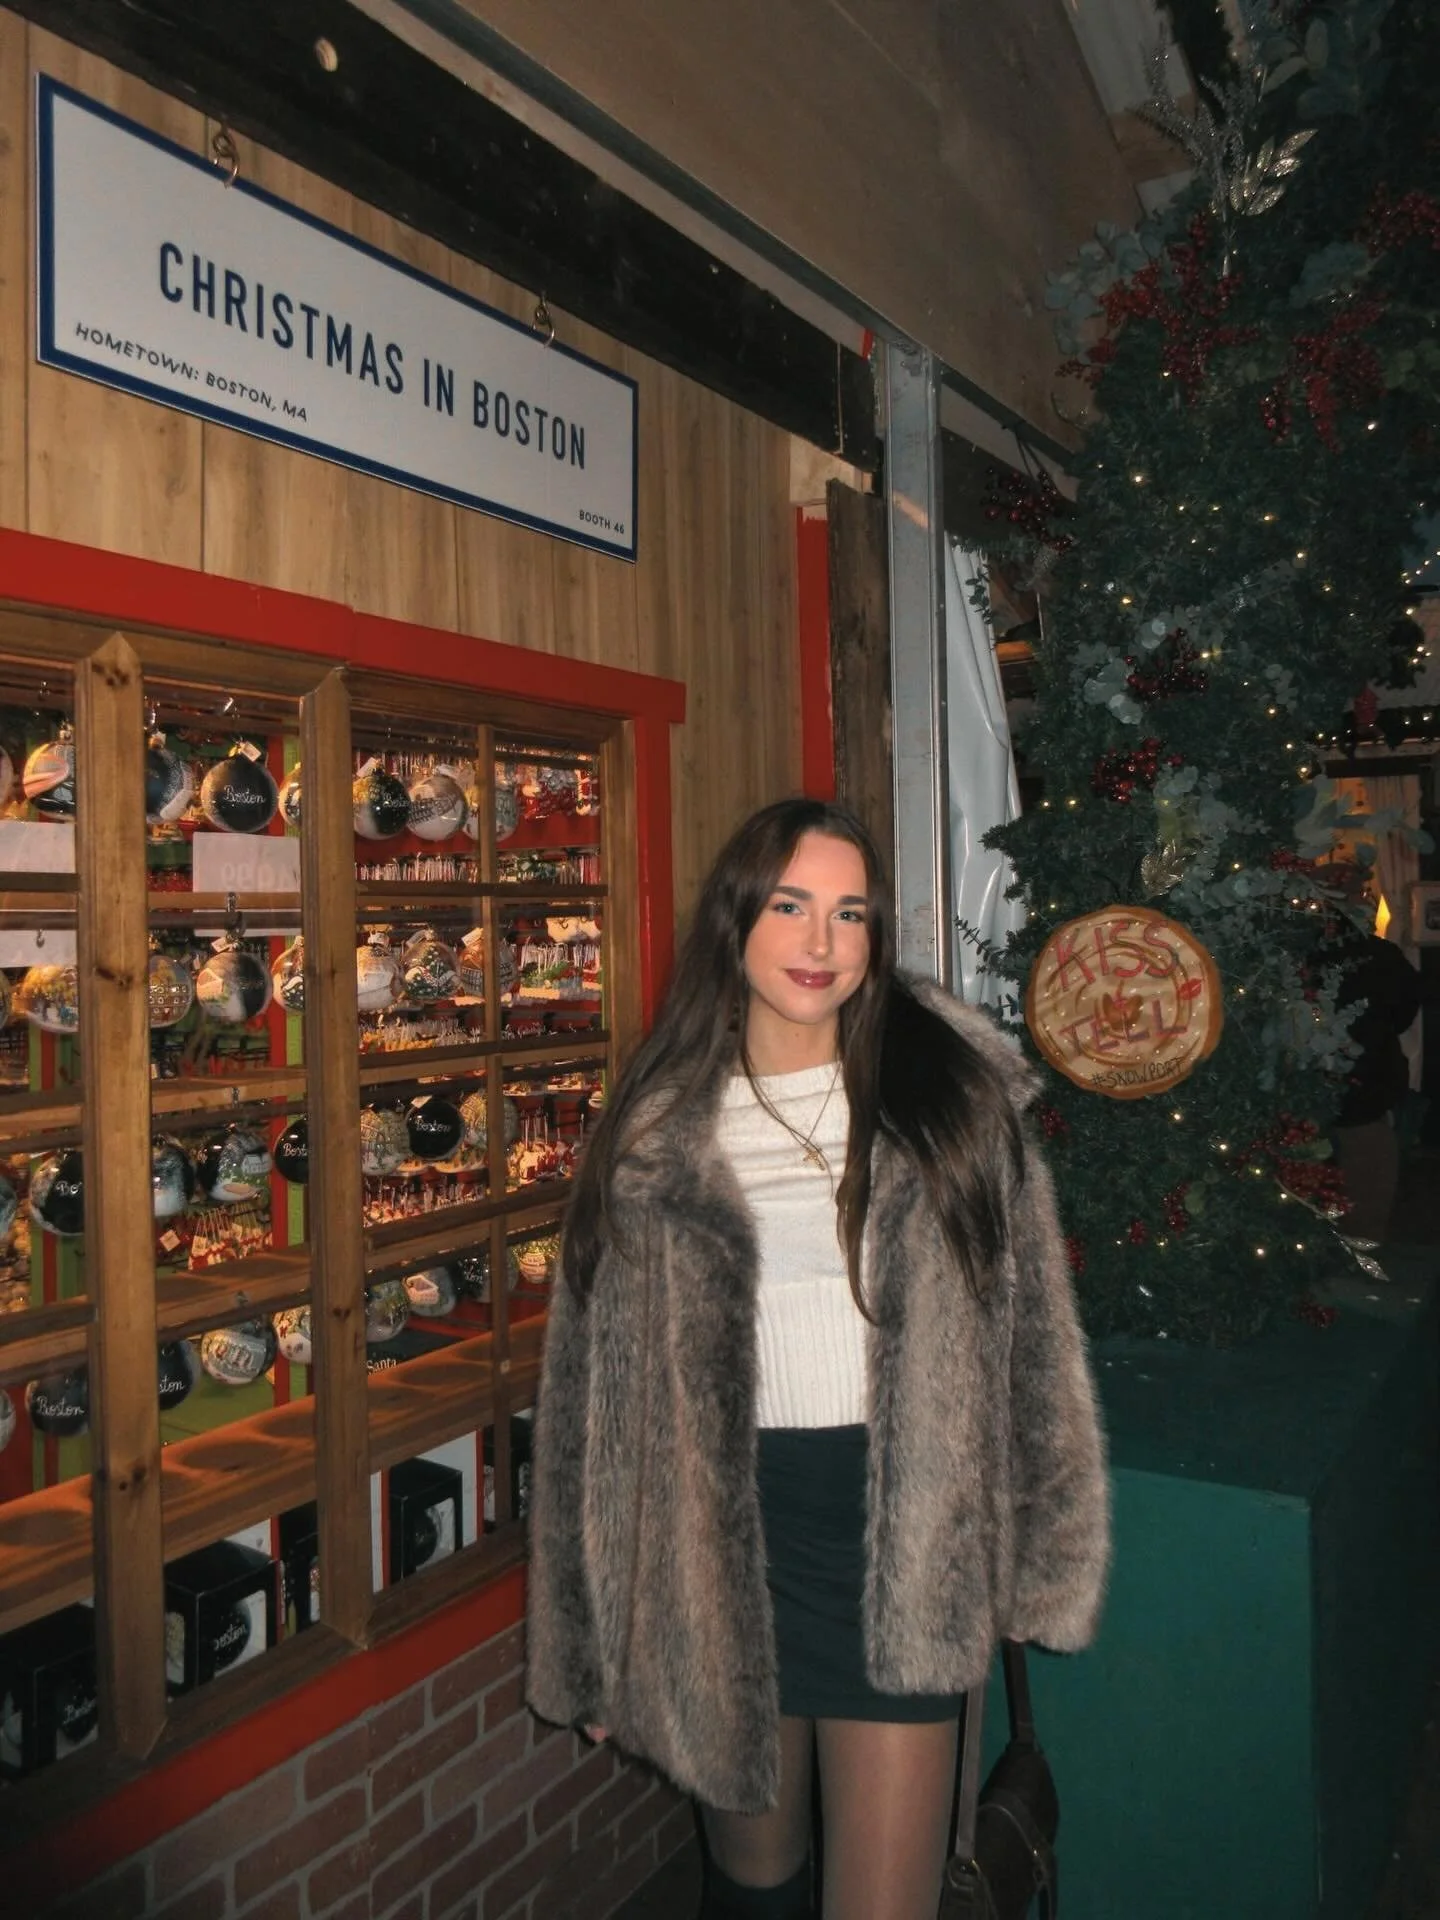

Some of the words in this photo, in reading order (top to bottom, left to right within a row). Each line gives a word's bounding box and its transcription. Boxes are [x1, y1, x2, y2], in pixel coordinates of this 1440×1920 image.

[159, 241, 404, 395] CHRISTMAS
[424, 358, 454, 417] IN
[473, 379, 585, 470] BOSTON
[75, 322, 200, 380] HOMETOWN:
[206, 371, 278, 412] BOSTON,
[282, 399, 308, 423] MA
[579, 509, 611, 529] BOOTH
[613, 521, 625, 535] 46
[223, 784, 265, 803] Boston
[1055, 919, 1180, 993] KISS
[1057, 999, 1188, 1057] TELL
[282, 1142, 308, 1157] Bost
[159, 1374, 186, 1393] ston
[36, 1395, 85, 1417] Boston
